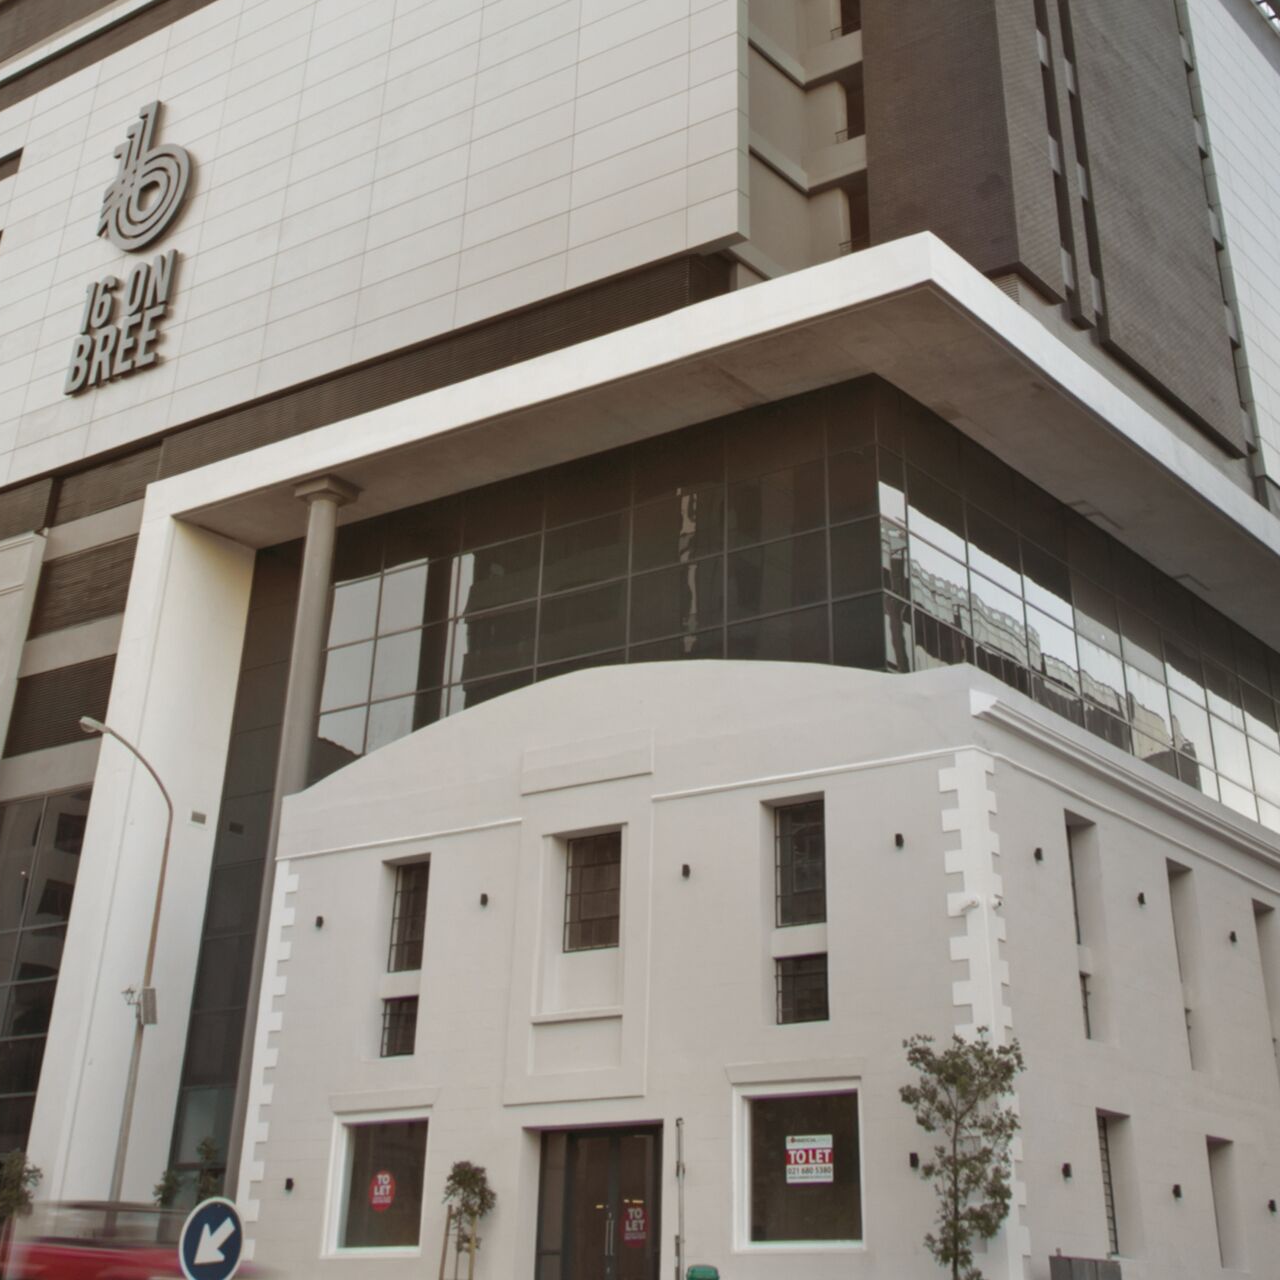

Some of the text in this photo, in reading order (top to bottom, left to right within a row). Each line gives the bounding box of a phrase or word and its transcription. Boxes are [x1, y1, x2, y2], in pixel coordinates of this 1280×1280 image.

[80, 248, 179, 336] 16 ON
[63, 304, 169, 397] BREE
[788, 1149, 832, 1164] TO LET
[377, 1173, 391, 1185] TO
[374, 1185, 391, 1196] LET
[627, 1208, 643, 1220] TO
[625, 1219, 645, 1232] LET
